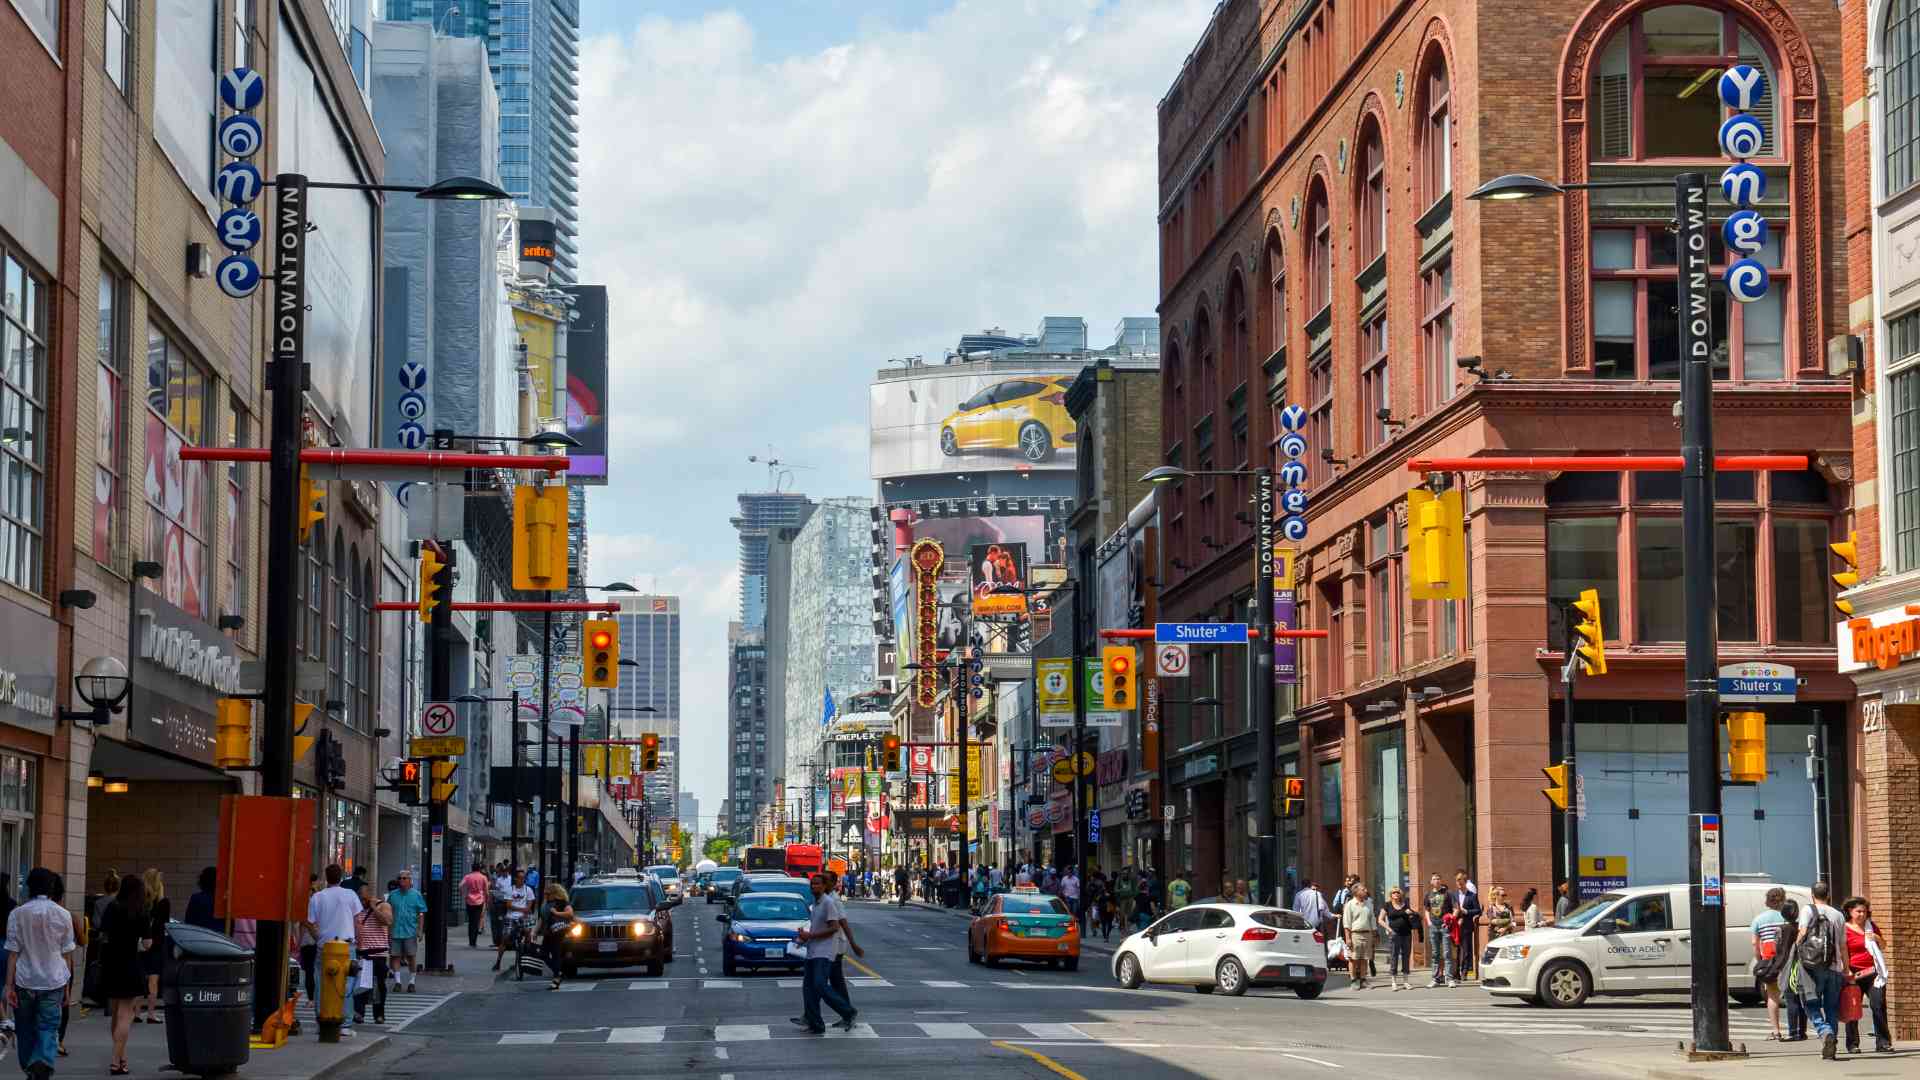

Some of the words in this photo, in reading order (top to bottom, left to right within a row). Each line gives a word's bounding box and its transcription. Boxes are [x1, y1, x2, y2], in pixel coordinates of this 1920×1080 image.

[216, 67, 264, 298] Yonge
[1719, 65, 1769, 302] Yonge
[280, 187, 299, 352] DOWNTOWN
[1688, 187, 1709, 357] DOWNTOWN
[1261, 475, 1273, 573] DOWNTOWN
[1280, 404, 1308, 542] Yonge
[1176, 625, 1219, 638] Shuter
[1732, 680, 1770, 692] Shuter
[1863, 703, 1884, 731] 221
[199, 989, 221, 1002] Litter
